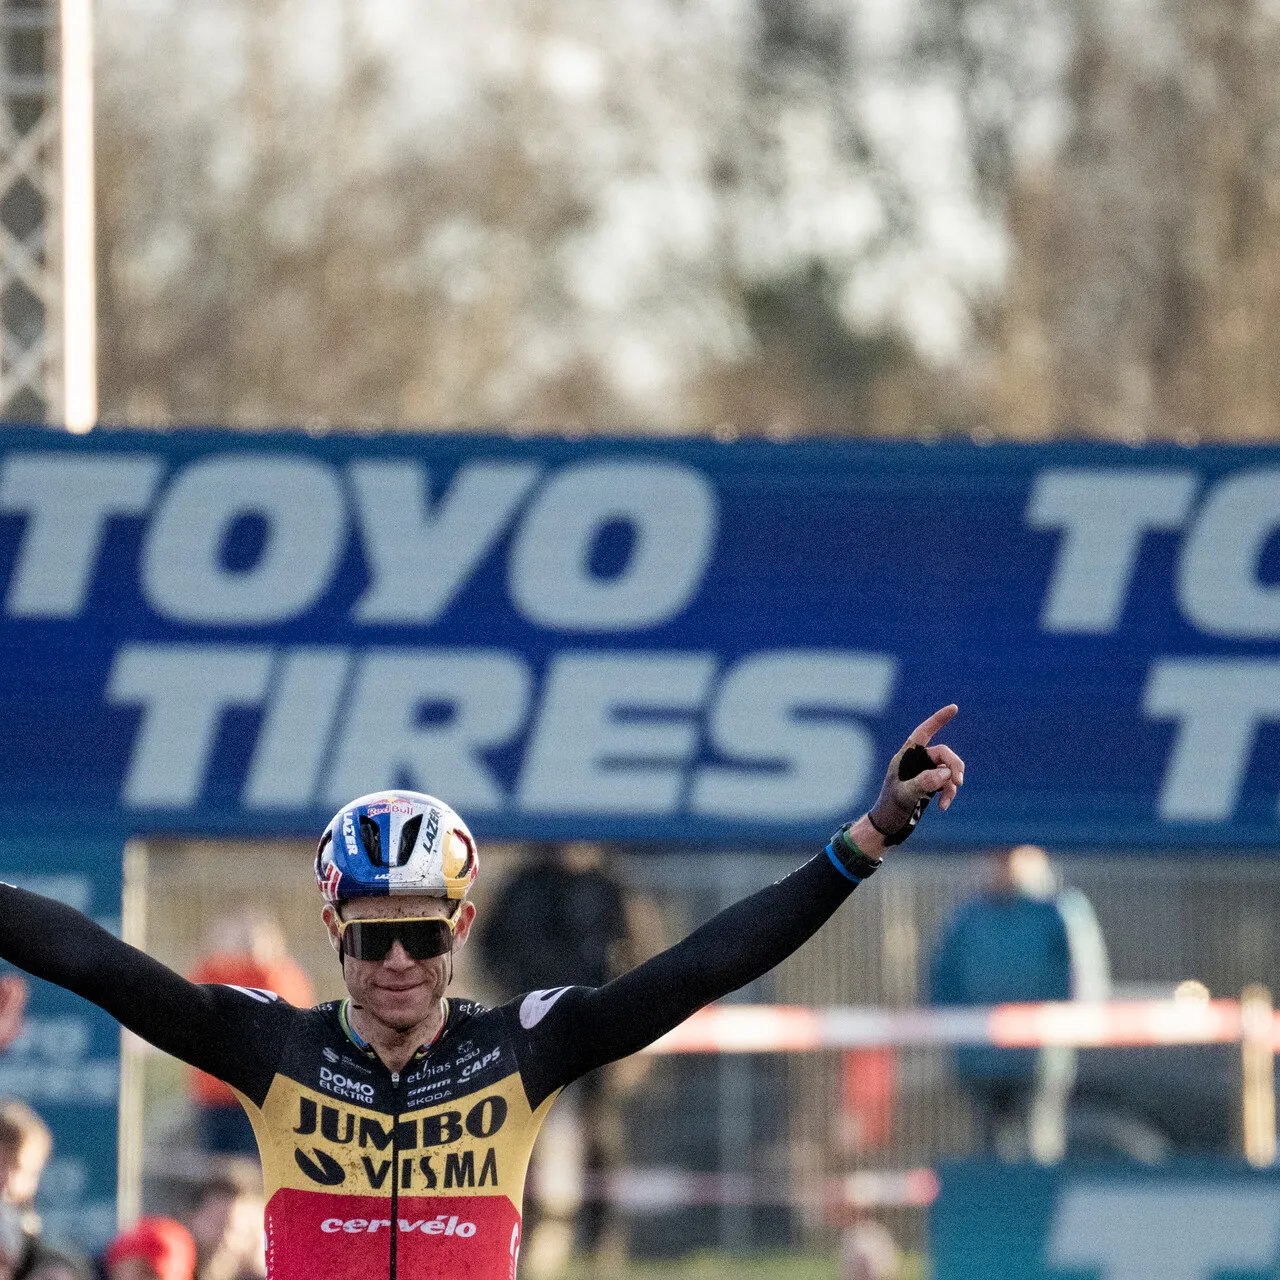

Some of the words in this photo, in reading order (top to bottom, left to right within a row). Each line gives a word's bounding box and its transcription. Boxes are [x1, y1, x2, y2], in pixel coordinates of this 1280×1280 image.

[106, 643, 899, 819] TIRES
[368, 804, 390, 817] Red
[391, 804, 413, 815] Bull
[342, 812, 359, 856] LAZER
[422, 808, 440, 855] LAZER
[407, 1059, 451, 1083] ethias
[462, 1046, 501, 1077] CAPS
[319, 1080, 373, 1104] ELEKTRO
[320, 1066, 375, 1096] DOMO
[407, 1078, 451, 1096] SRAM
[407, 1090, 452, 1107] SKODA
[293, 1095, 507, 1151] JUMBO
[360, 1148, 498, 1189] VISMA
[321, 1215, 477, 1237] cervélo
